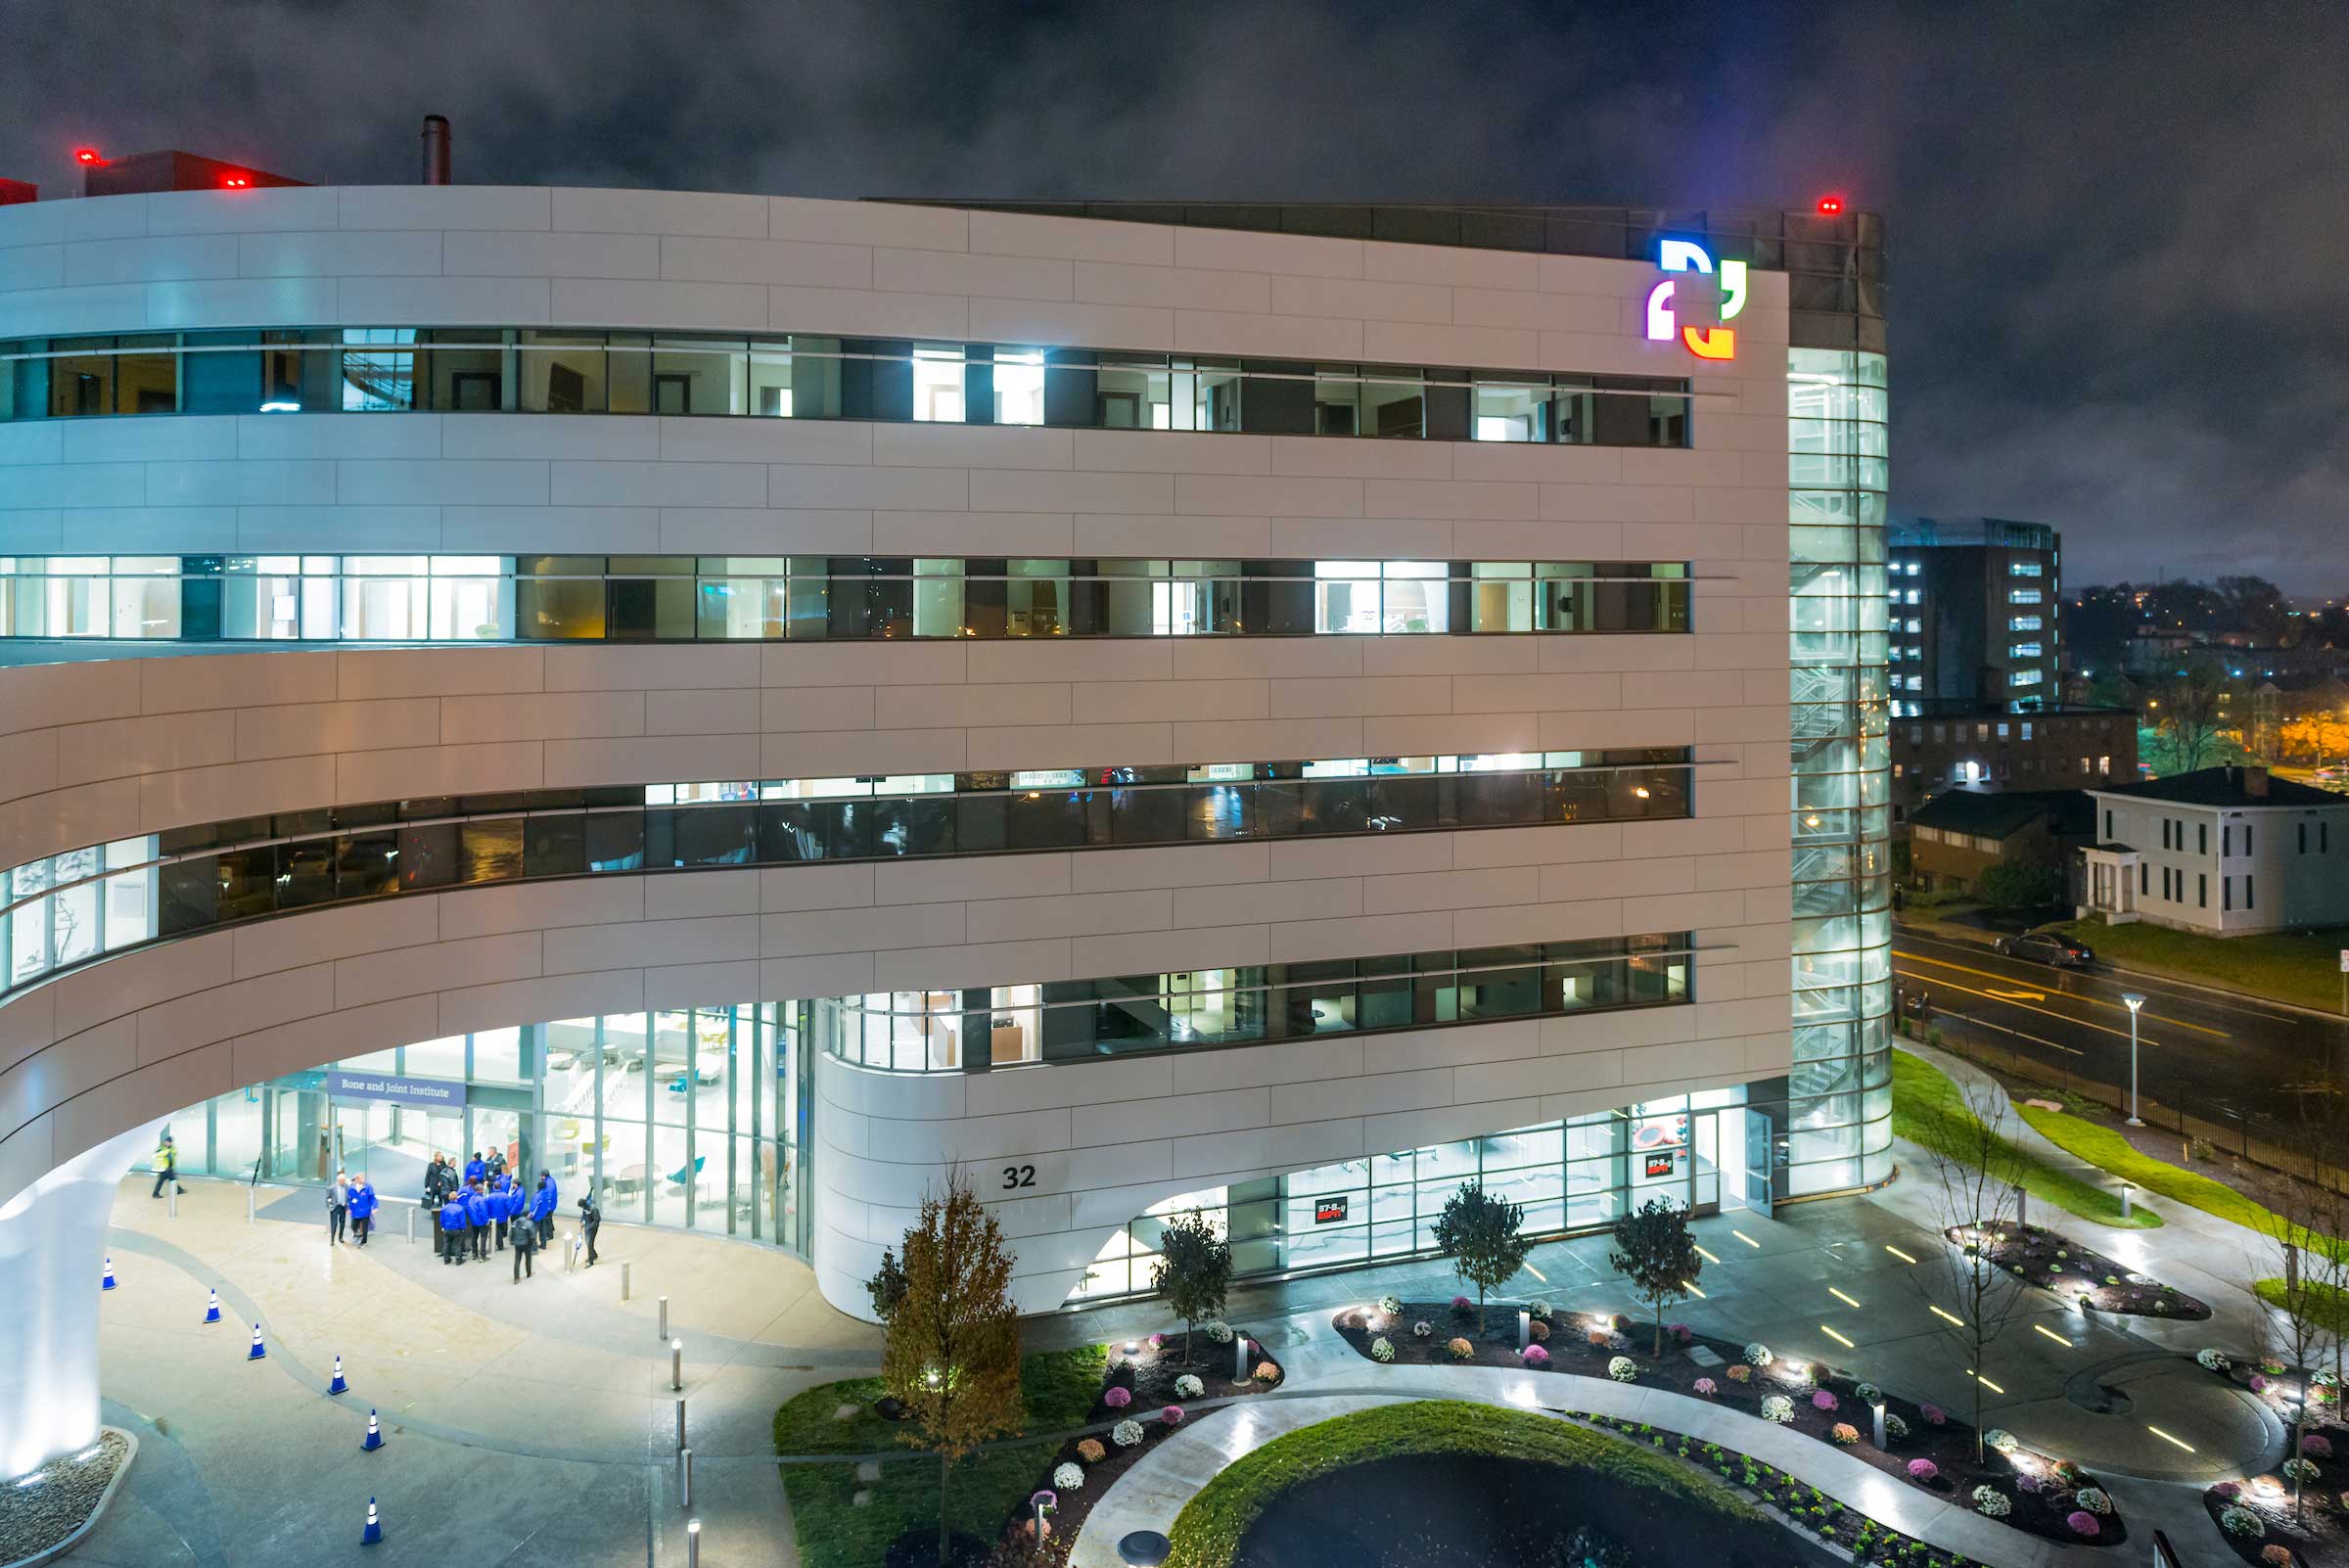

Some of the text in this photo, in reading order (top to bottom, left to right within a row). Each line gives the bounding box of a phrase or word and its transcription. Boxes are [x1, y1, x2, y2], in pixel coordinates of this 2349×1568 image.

[342, 1079, 450, 1098] Bone and Joint Institute
[1002, 1165, 1036, 1190] 32
